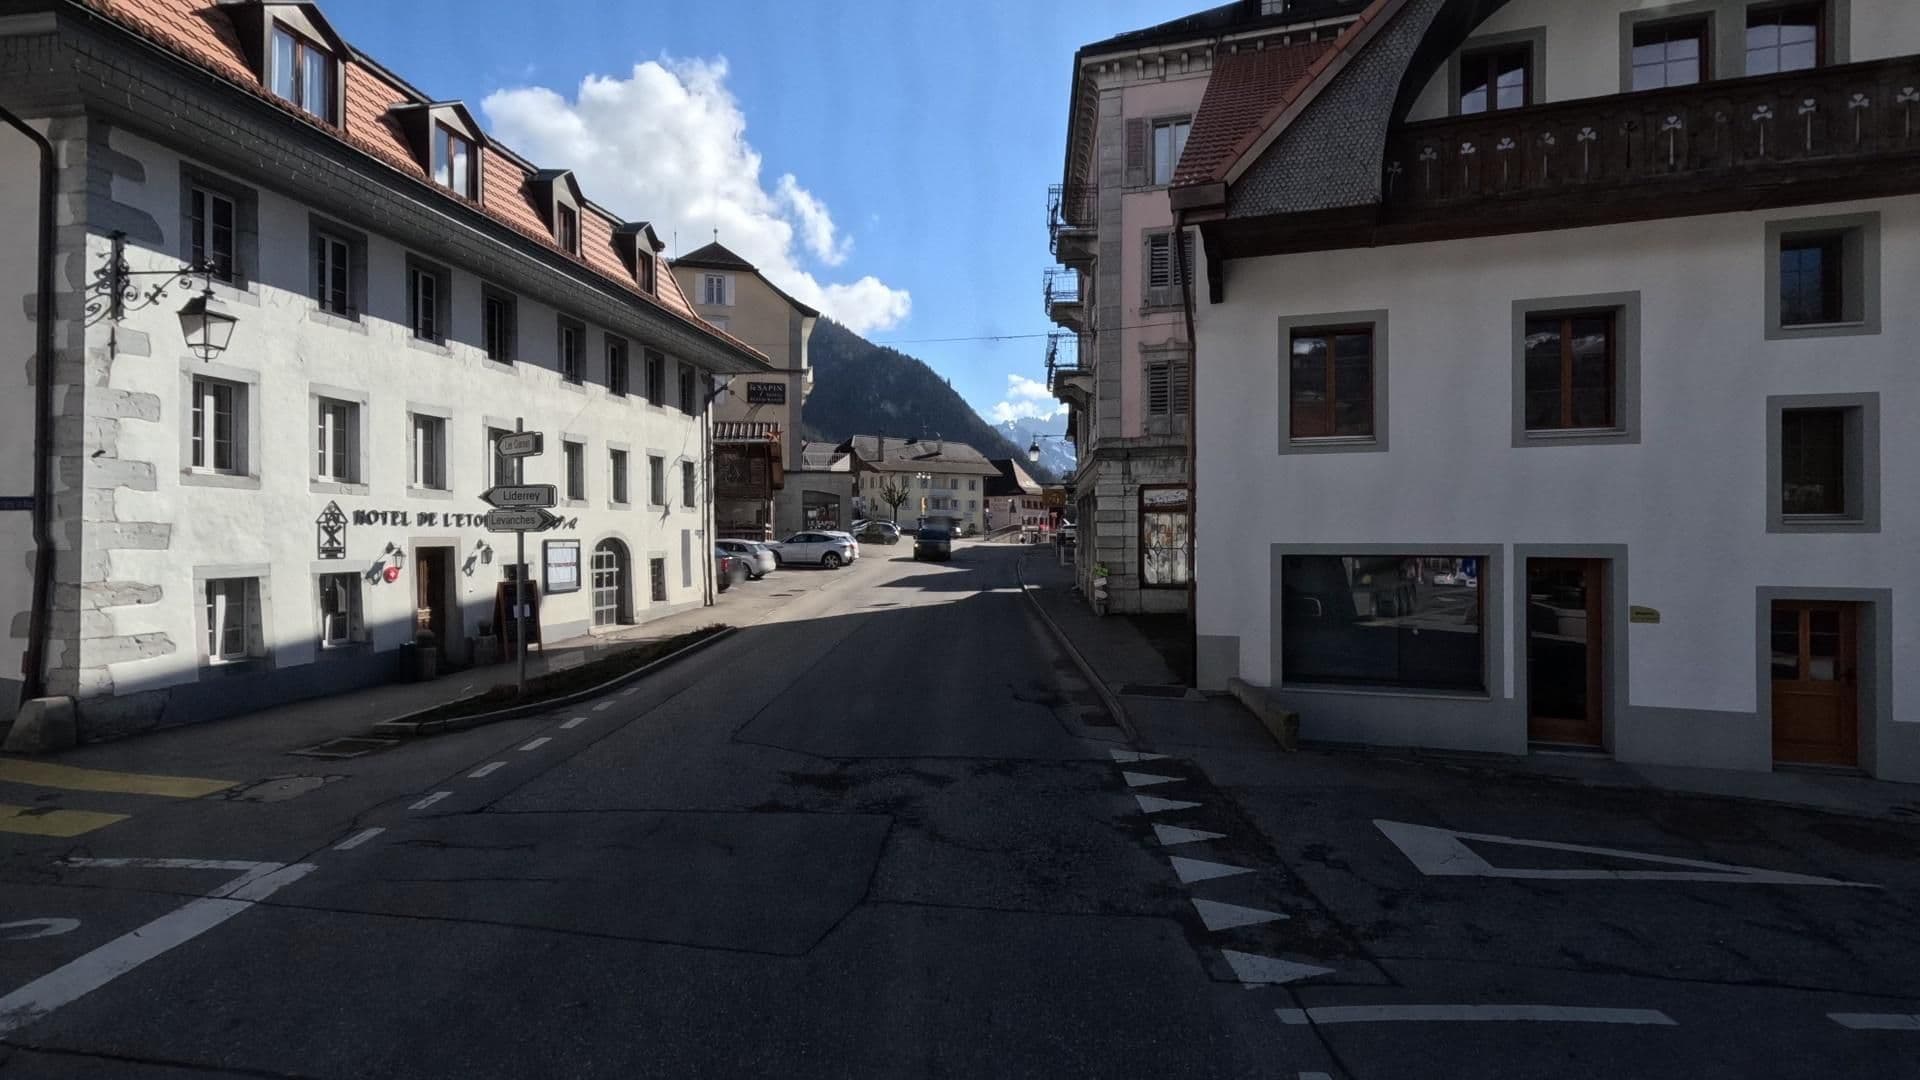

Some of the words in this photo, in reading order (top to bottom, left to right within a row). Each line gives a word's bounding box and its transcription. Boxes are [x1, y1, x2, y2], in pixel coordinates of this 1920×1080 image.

[503, 490, 540, 503] Liderrey
[353, 510, 412, 526] HOTEL
[416, 512, 438, 527] DE
